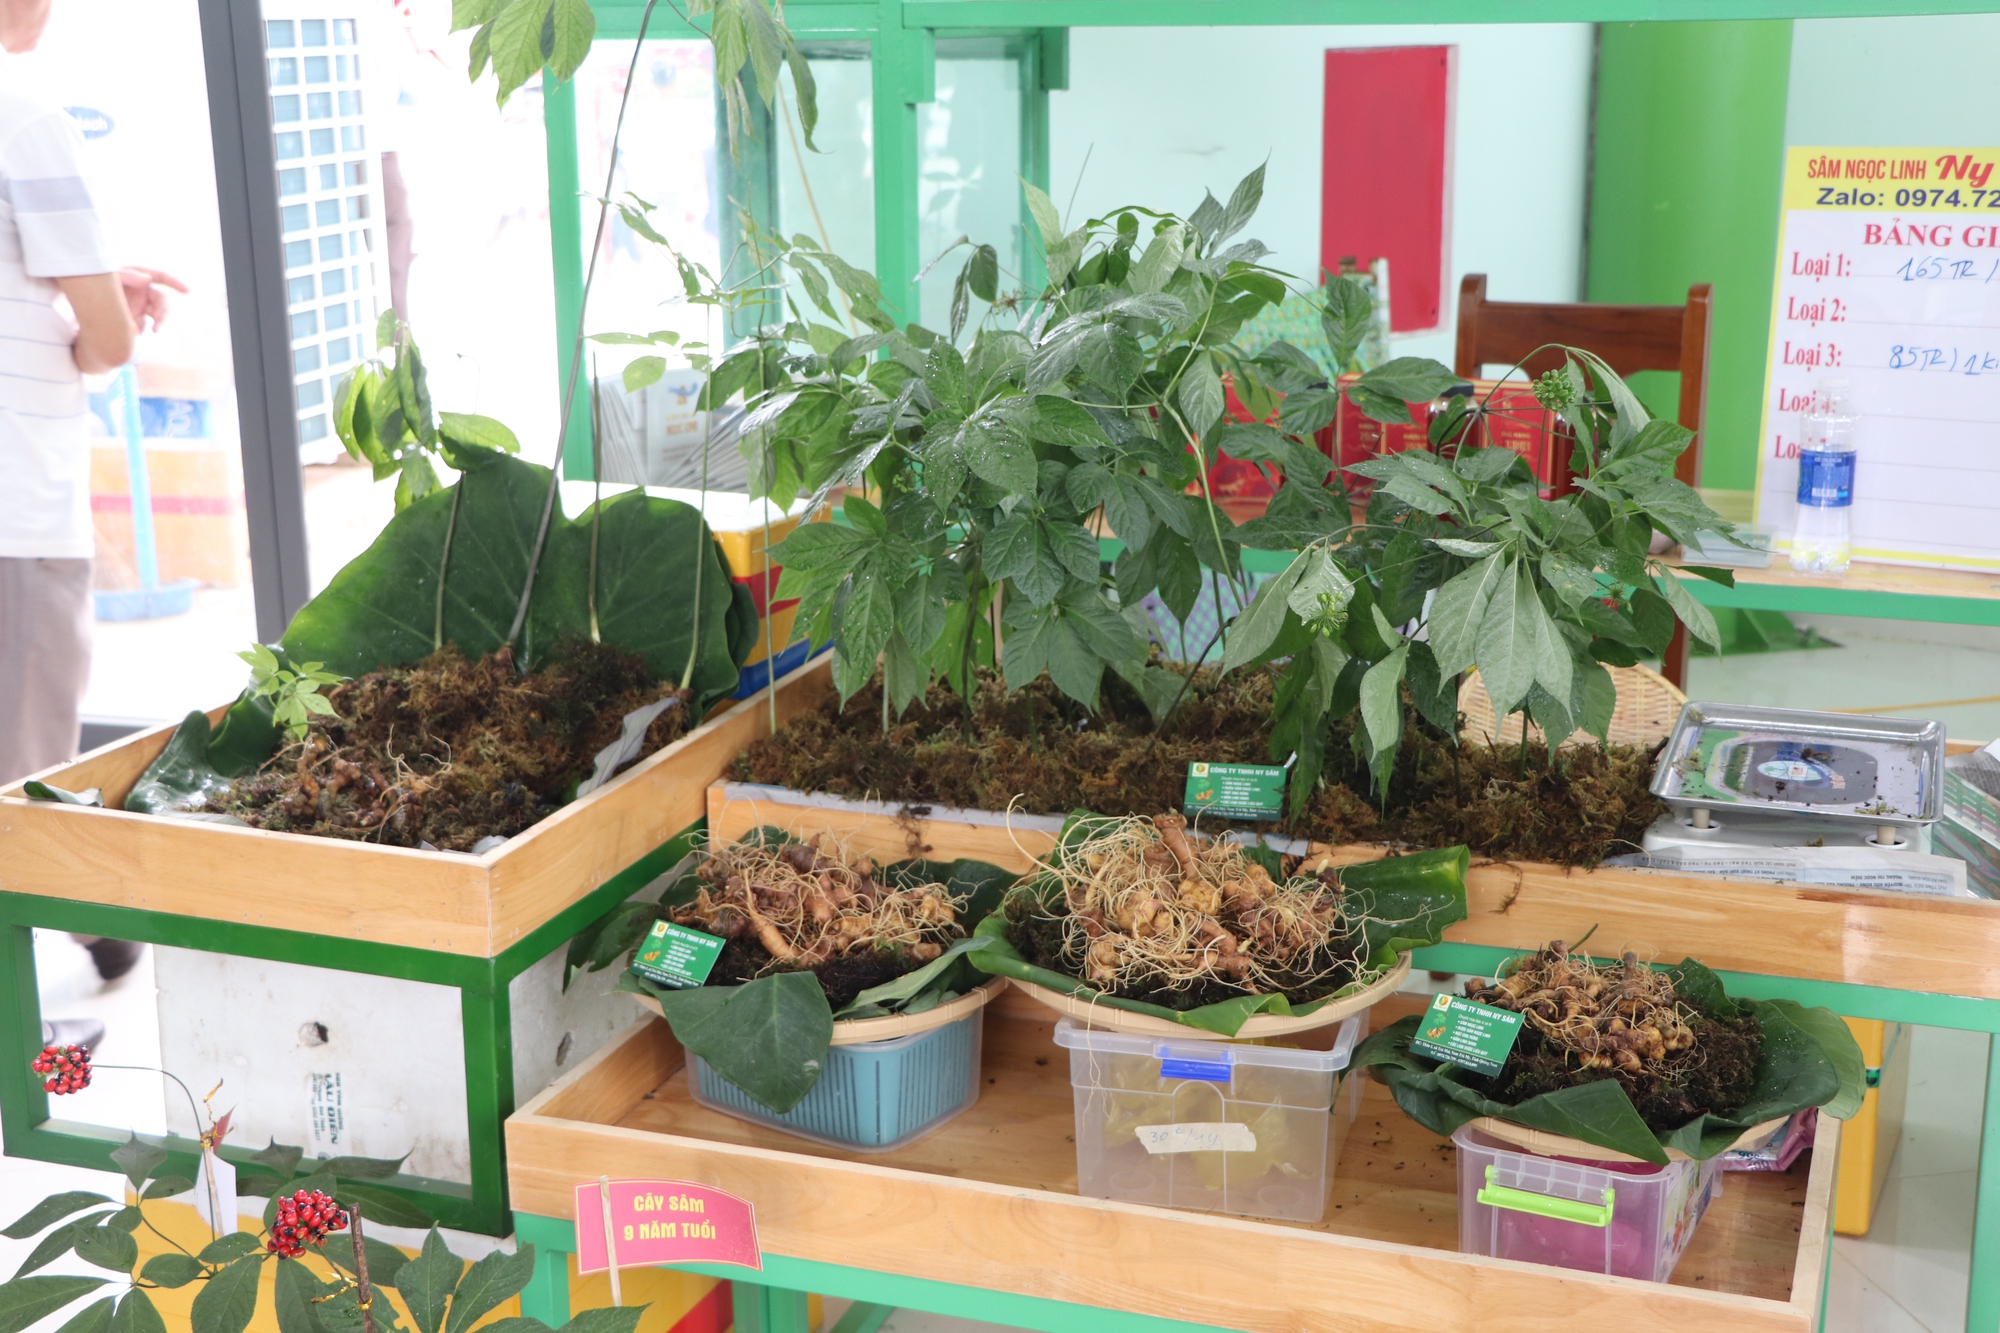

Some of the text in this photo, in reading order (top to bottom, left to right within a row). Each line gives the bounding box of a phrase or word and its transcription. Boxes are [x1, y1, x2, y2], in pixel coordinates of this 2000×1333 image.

[1807, 155, 1995, 188] SÂM NGỌC LINH Ny
[1816, 187, 1884, 206] Zalo:
[1863, 218, 2000, 248] BẢNG GI
[1791, 251, 1851, 282] Loại 1:
[1787, 296, 1846, 327] Loại 2:
[1783, 341, 1842, 372] Loại 3:
[1451, 1001, 1516, 1024] CÔNG TY TNHH NY SÂM
[633, 1192, 704, 1213] CÂY SÂM
[623, 1219, 716, 1241] 9 NĂM TUỔI
